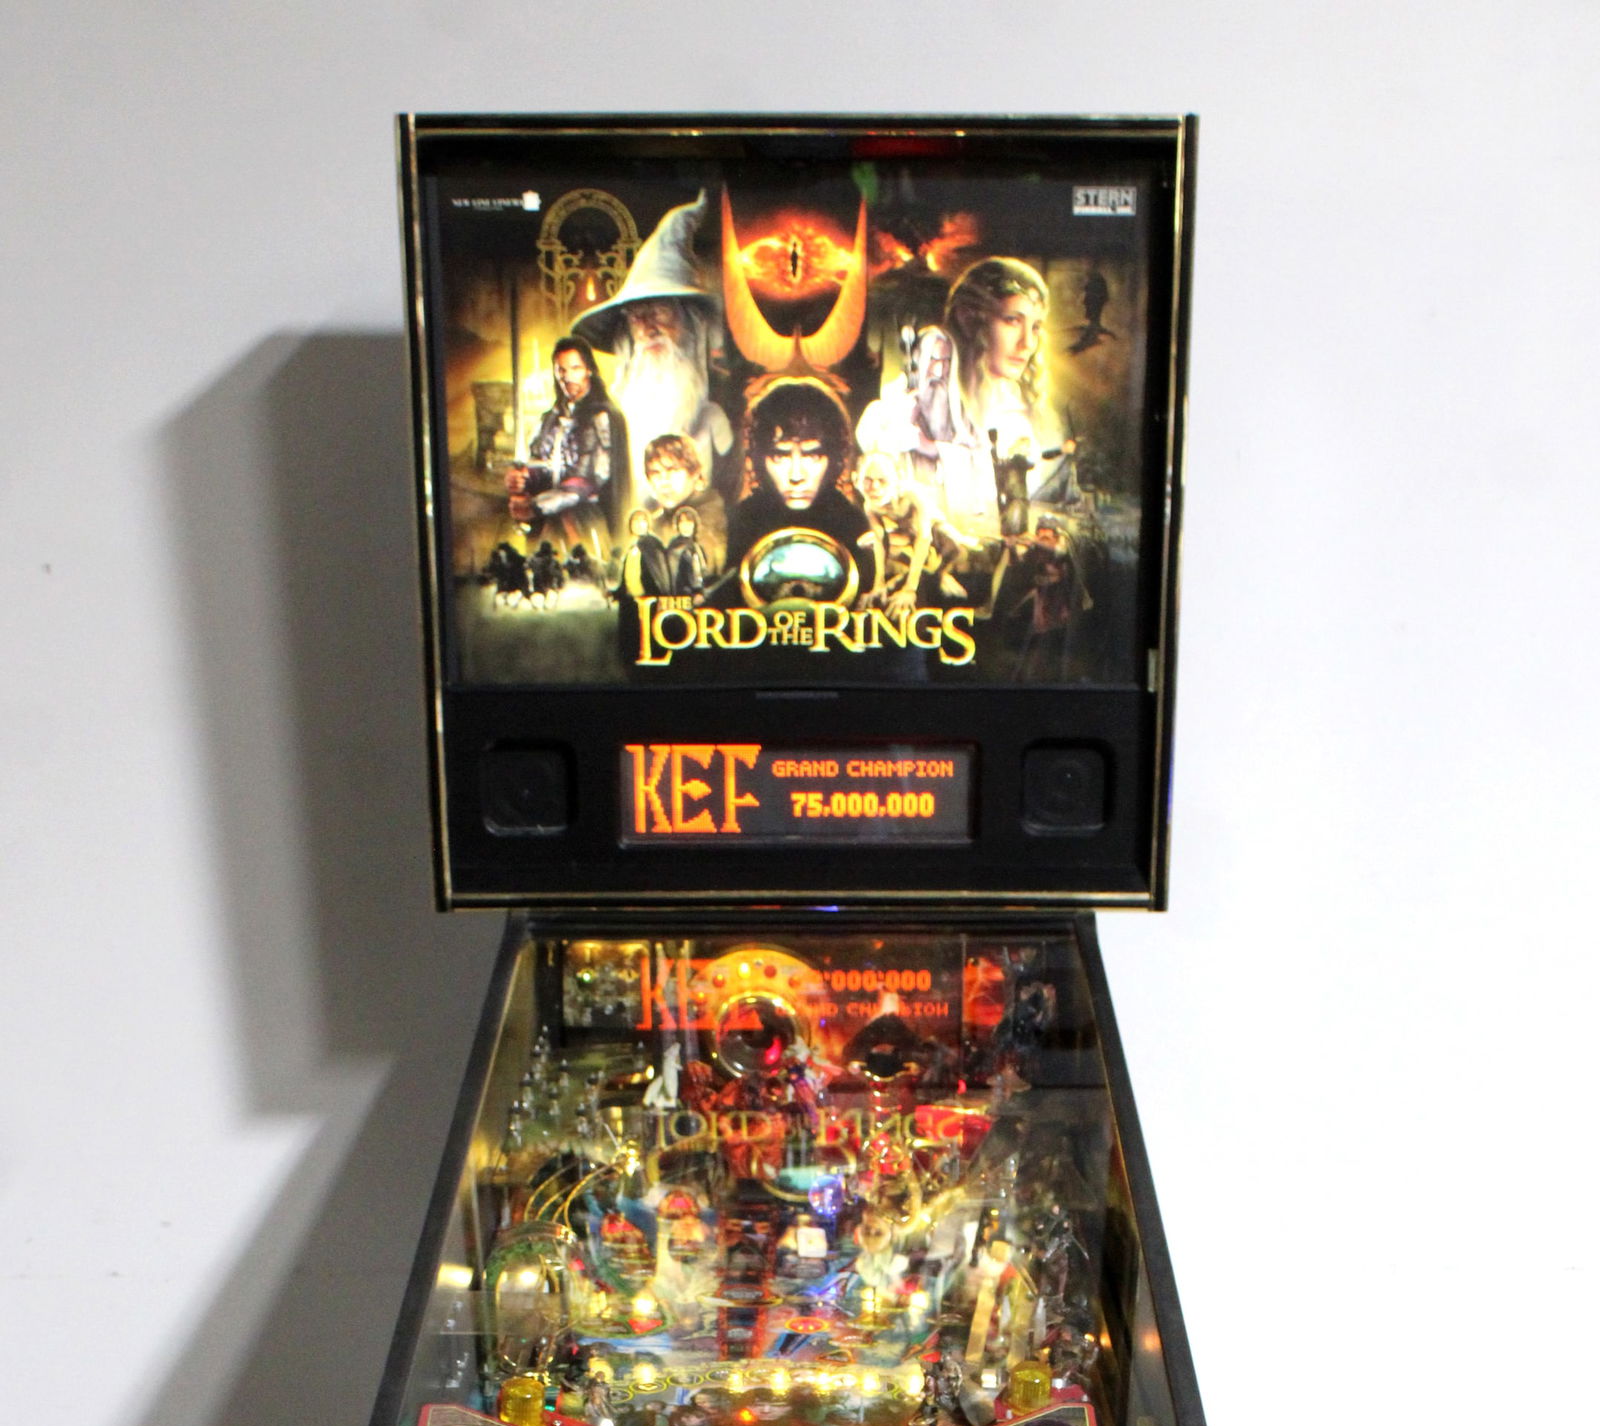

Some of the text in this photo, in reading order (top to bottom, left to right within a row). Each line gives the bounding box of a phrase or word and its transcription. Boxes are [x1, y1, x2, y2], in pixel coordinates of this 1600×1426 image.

[1074, 186, 1136, 207] STERN
[657, 596, 692, 610] THE
[635, 596, 976, 666] LORD OF THE RINGS
[625, 744, 954, 833] KEF GRAND CHAMPION
